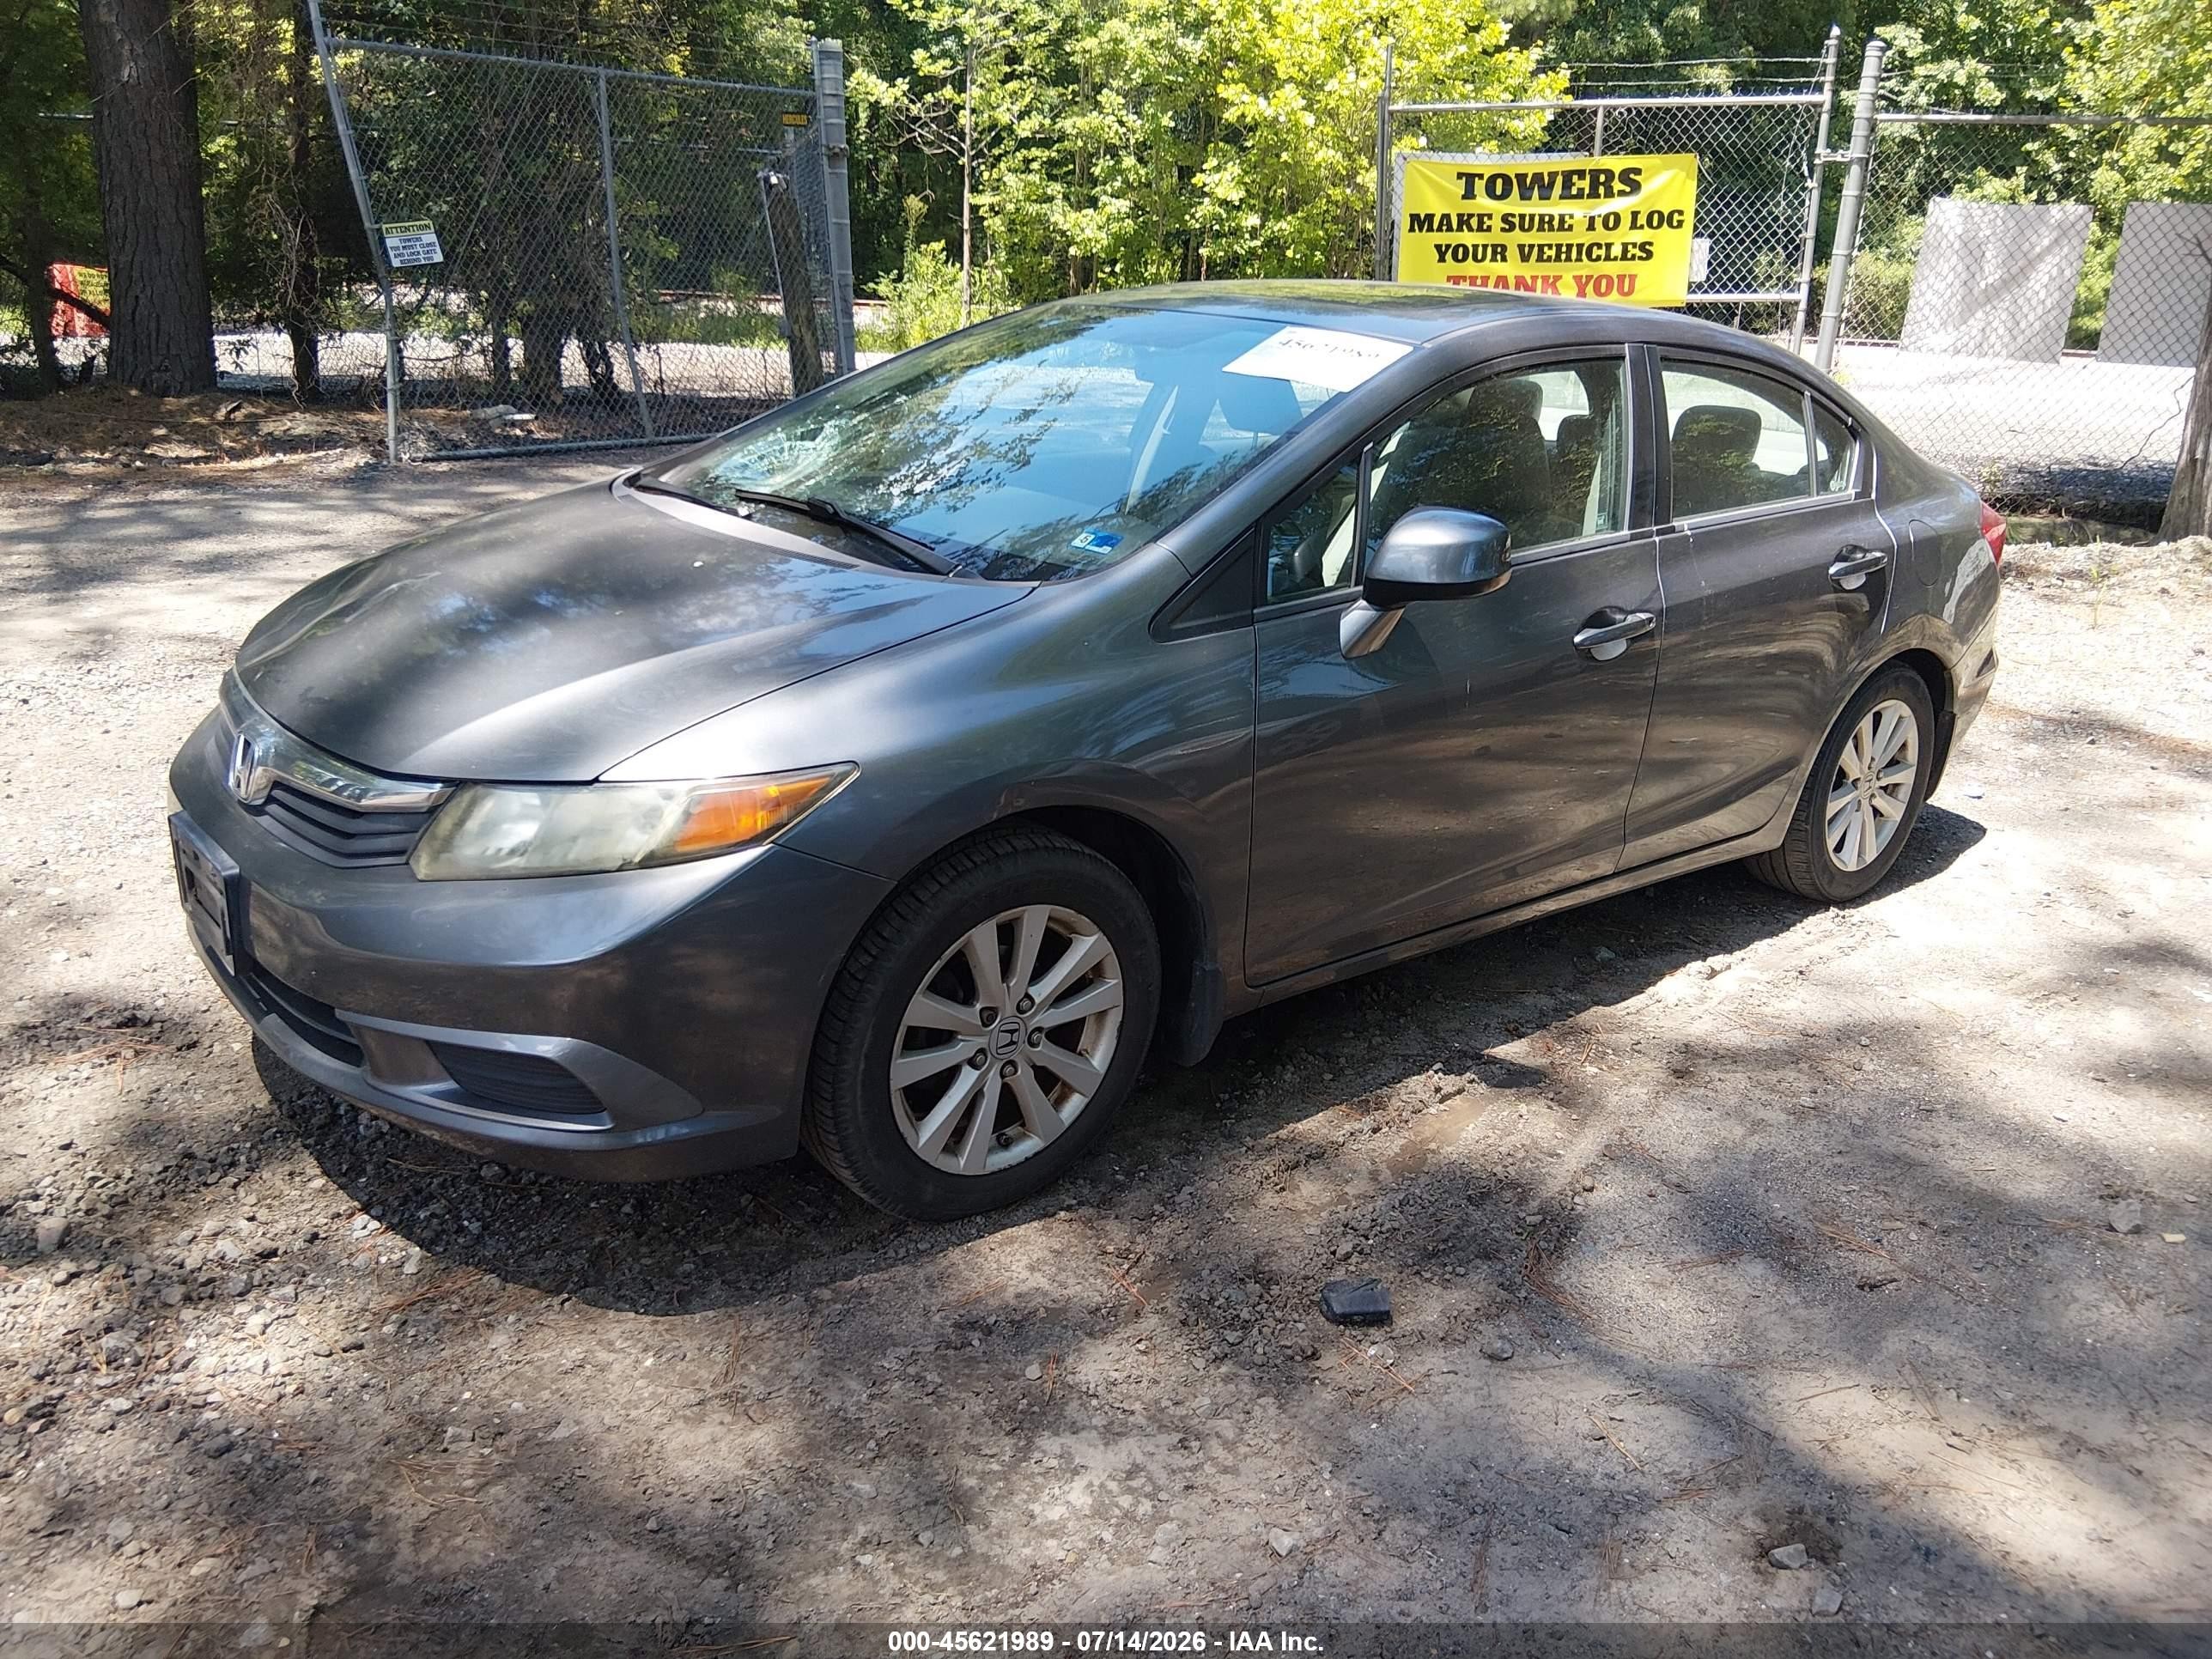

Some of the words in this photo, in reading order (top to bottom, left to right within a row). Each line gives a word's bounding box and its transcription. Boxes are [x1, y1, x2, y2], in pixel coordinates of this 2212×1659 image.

[1456, 167, 1643, 201] TOWERS
[386, 223, 432, 235] ATTENTION
[1407, 212, 1493, 234] MAKE
[1500, 212, 1574, 233] SURE
[1583, 210, 1621, 232] TO
[1629, 210, 1685, 230] LOG
[1433, 243, 1508, 264] YOUR
[1516, 240, 1654, 263] VEHICLES
[1572, 274, 1638, 298] YOU
